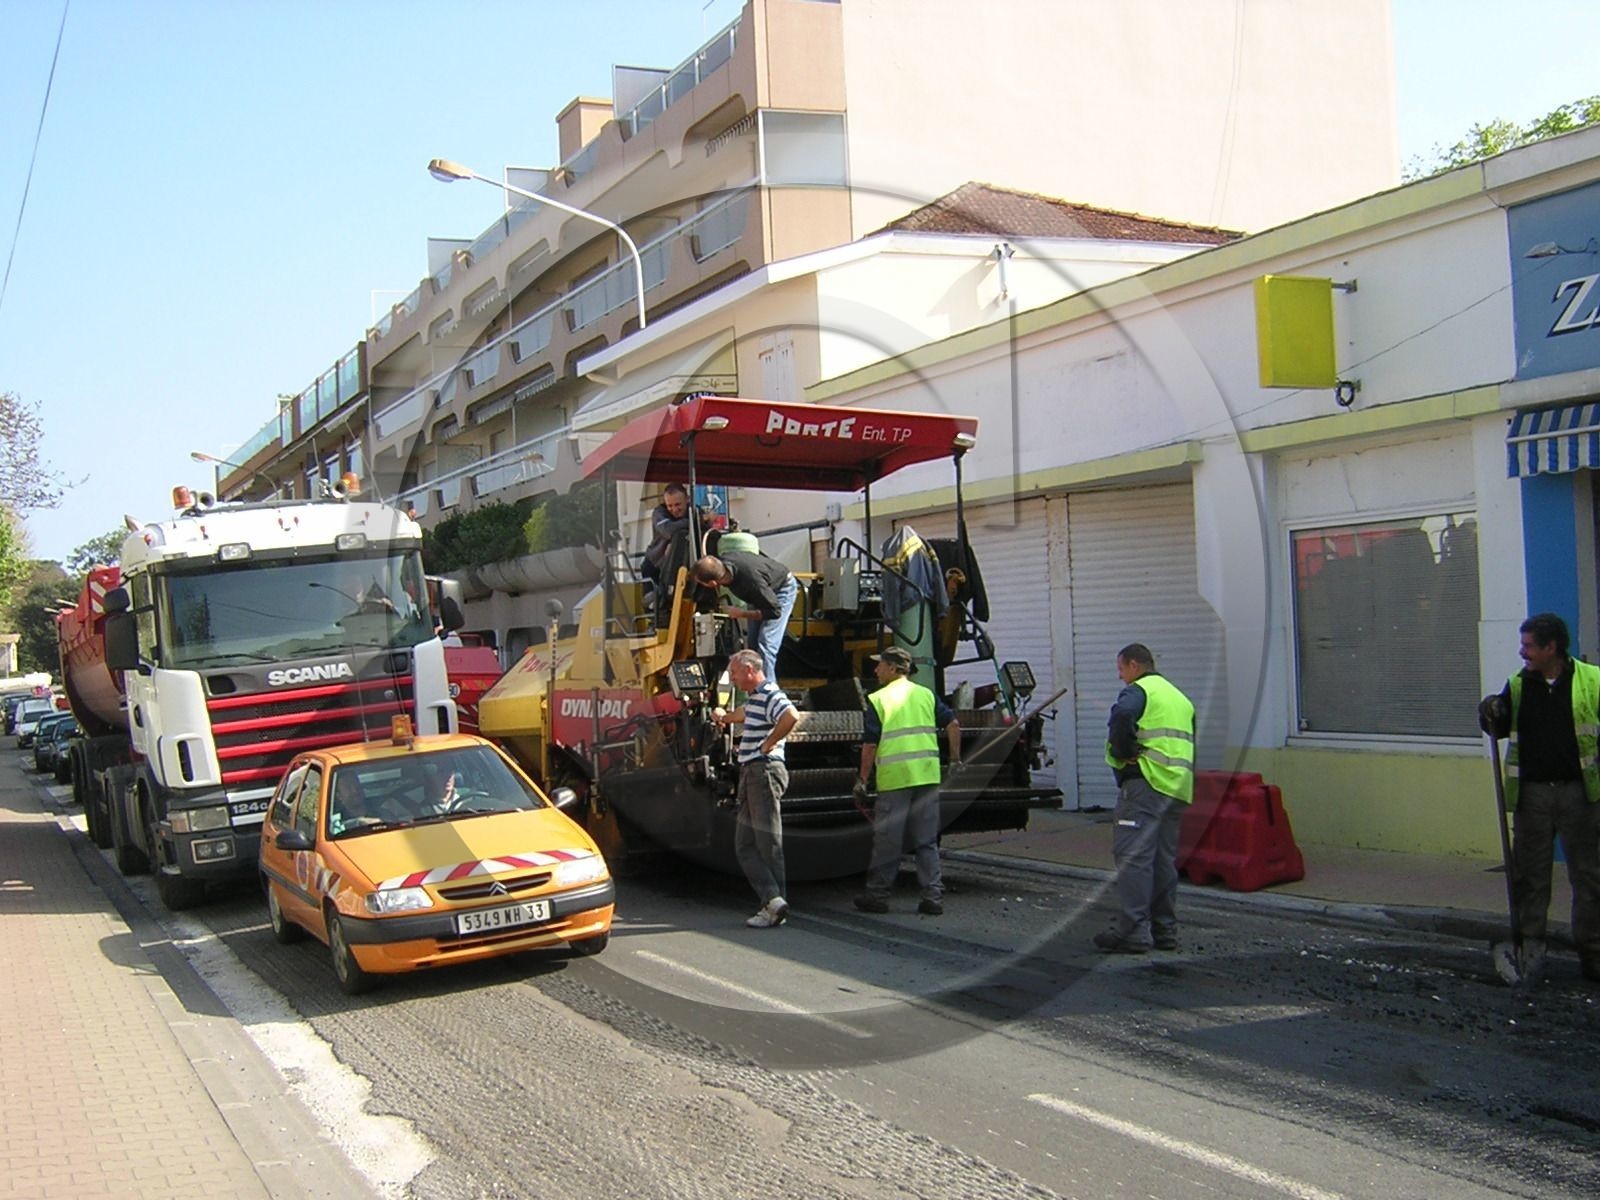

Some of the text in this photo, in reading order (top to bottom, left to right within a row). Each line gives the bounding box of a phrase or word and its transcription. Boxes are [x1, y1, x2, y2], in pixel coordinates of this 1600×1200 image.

[1546, 272, 1600, 337] Z
[268, 662, 354, 686] SCANIA
[561, 698, 632, 719] DYNAPAC
[464, 911, 501, 930] 5349
[526, 903, 544, 920] 33
